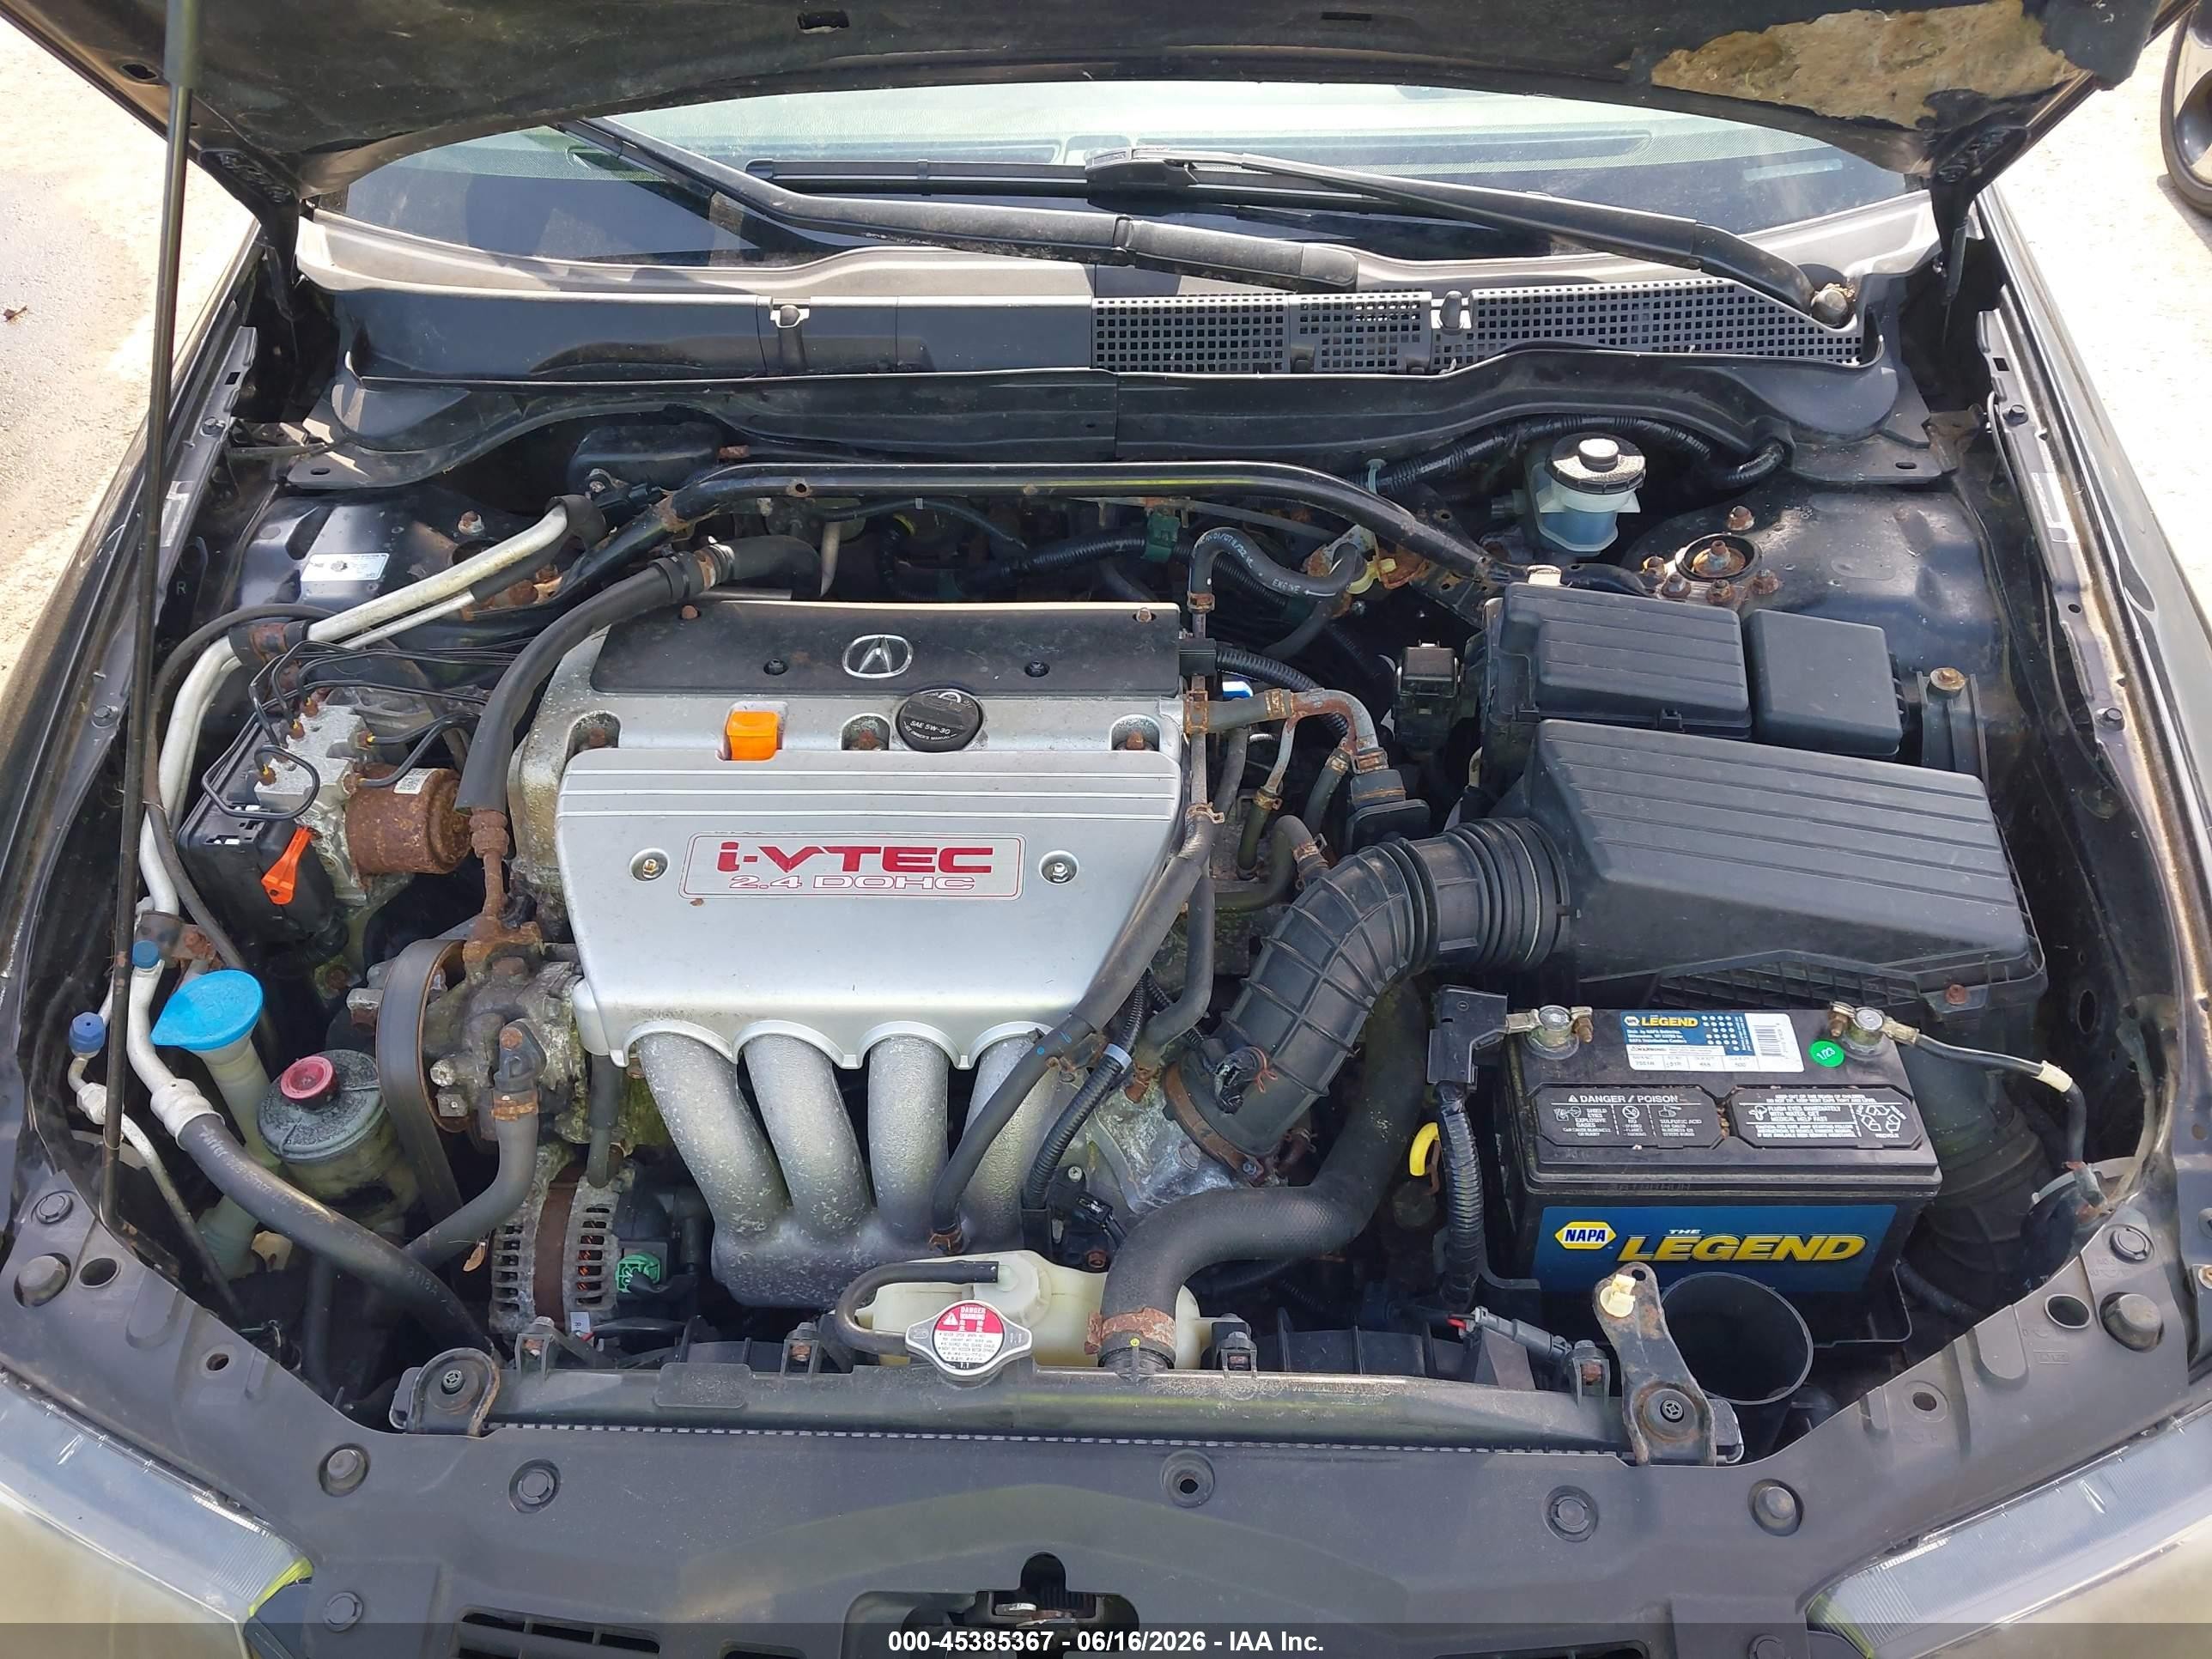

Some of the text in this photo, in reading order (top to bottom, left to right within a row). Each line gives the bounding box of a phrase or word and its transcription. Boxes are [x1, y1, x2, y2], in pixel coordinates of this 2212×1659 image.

[909, 720, 951, 735] SAE 5W-30
[717, 842, 994, 873] i-VTEC
[729, 874, 975, 890] 2.4 DOHC
[1641, 1016, 1698, 1027] LEGEND
[1579, 1095, 1626, 1103] DANGER
[1637, 1095, 1679, 1103] POISON
[1564, 1229, 1607, 1243] NAPA
[1617, 1233, 1869, 1263] LEGEND
